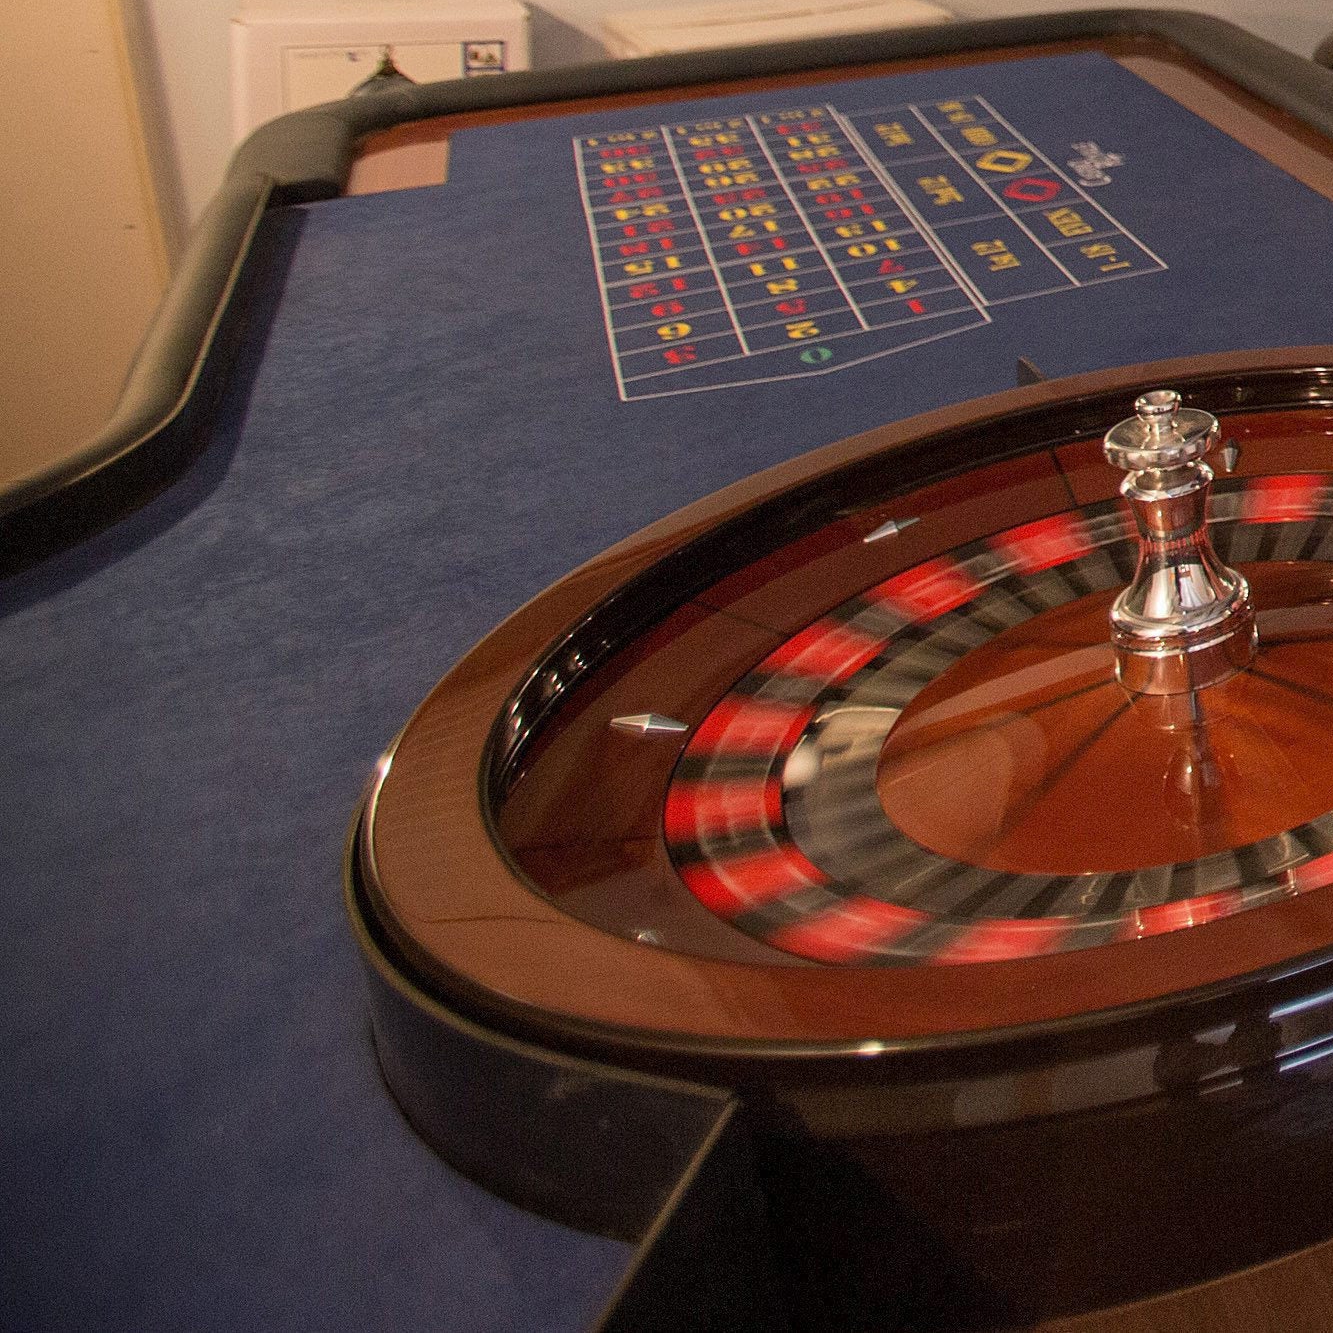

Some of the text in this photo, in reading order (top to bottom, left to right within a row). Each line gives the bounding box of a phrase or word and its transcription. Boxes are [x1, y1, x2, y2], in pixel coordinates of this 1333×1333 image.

[728, 219, 778, 239] 17
[834, 219, 887, 239] 13
[847, 237, 901, 258] 10
[623, 256, 681, 276] 15
[748, 257, 798, 277] 11
[878, 258, 906, 275] 7
[629, 277, 687, 299] 12
[766, 278, 798, 295] 8
[885, 279, 919, 294] 4
[651, 300, 684, 317] 9
[775, 298, 807, 316] 5
[906, 298, 926, 314] 1
[656, 322, 692, 341] 6
[785, 319, 820, 339] 2
[663, 345, 697, 365] 3
[800, 347, 833, 364] 0
